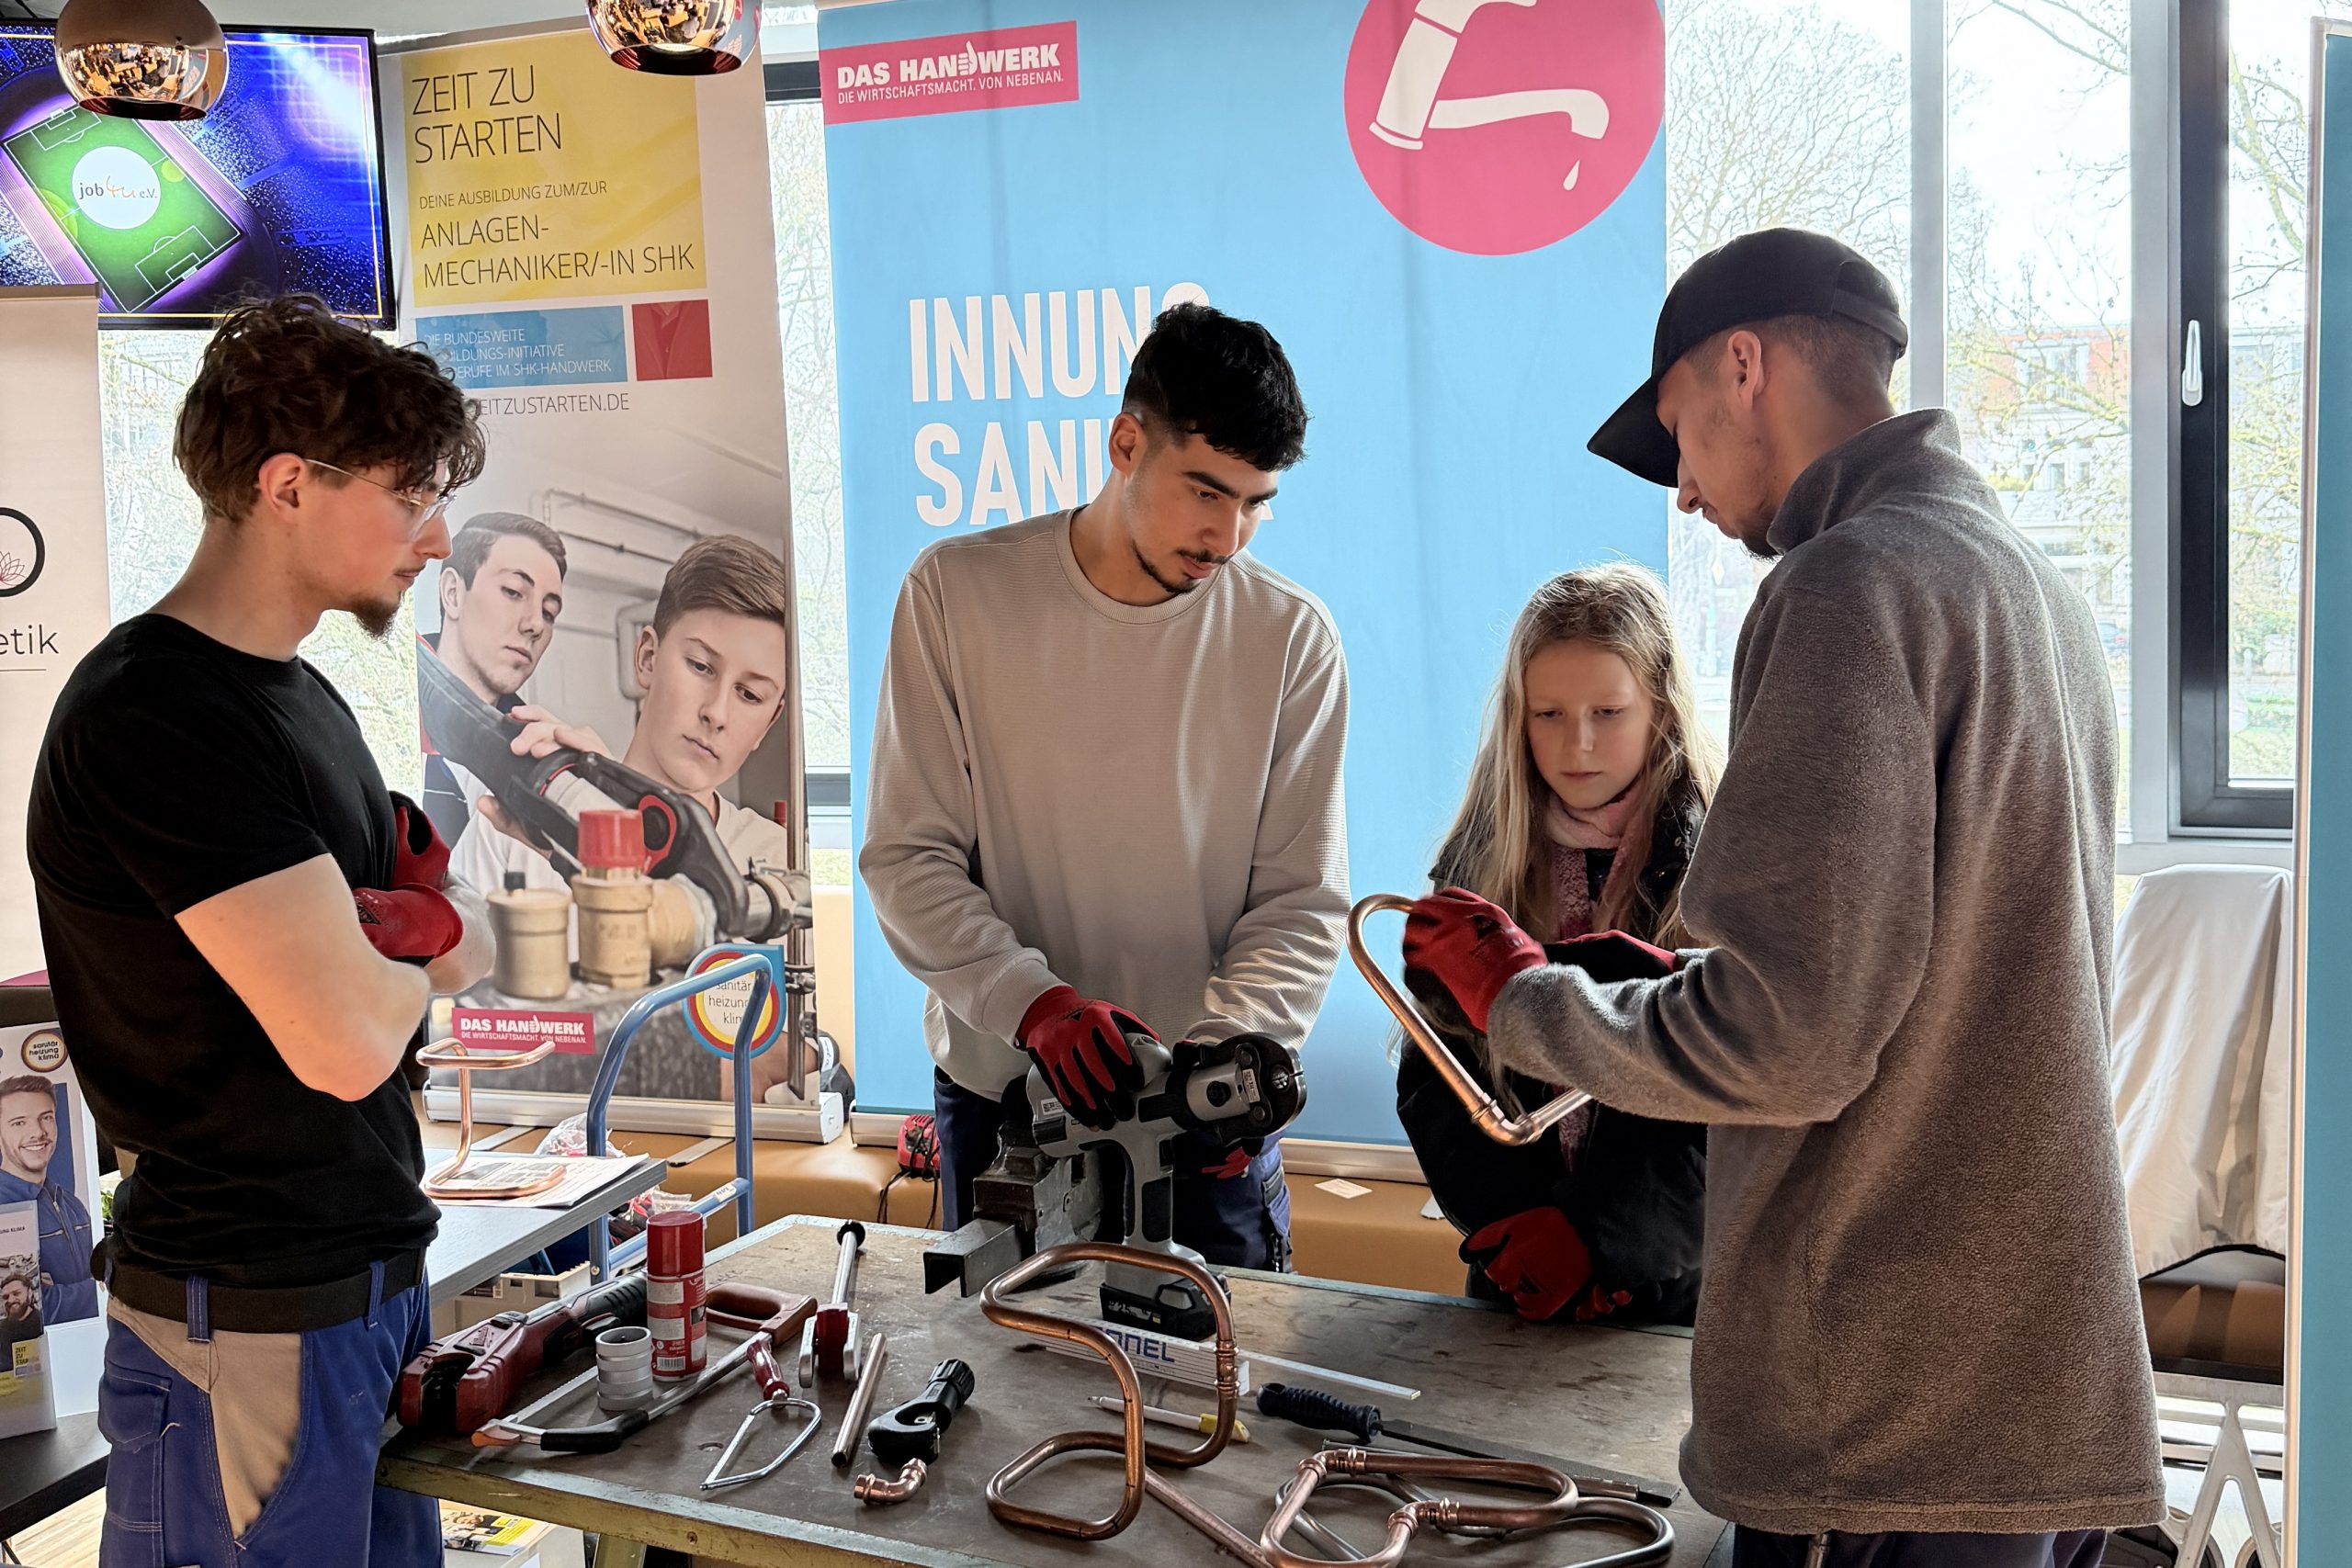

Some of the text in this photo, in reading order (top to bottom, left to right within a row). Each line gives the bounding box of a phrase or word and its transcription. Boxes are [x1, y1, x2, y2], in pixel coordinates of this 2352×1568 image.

[837, 40, 1060, 89] DAS HANDWERK
[412, 65, 534, 115] ZEIT ZU
[838, 70, 1064, 105] DIE WIRTSCHAFTSMACHT. VON NEBENAN.
[414, 112, 561, 164] STARTEN
[419, 180, 607, 209] DEINE AUSBILDUNG ZUM/ZUR
[421, 214, 549, 249] ANLAGEN-
[424, 243, 695, 288] MECHANIKER/-IN SHK
[444, 328, 526, 345] BUNDESWEITE
[910, 282, 1210, 402] INNUN
[449, 344, 565, 362] ILDUNGS-INITIATIVE
[455, 359, 612, 379] ERUFE IM SHK-HANDWERK
[480, 393, 630, 416] EITZUSTARTEN.DE
[460, 1014, 585, 1035] DAS HANDWERK
[472, 1032, 540, 1042] WIRTSCHAFTSMACHT.
[555, 1035, 587, 1043] NEBENAN.
